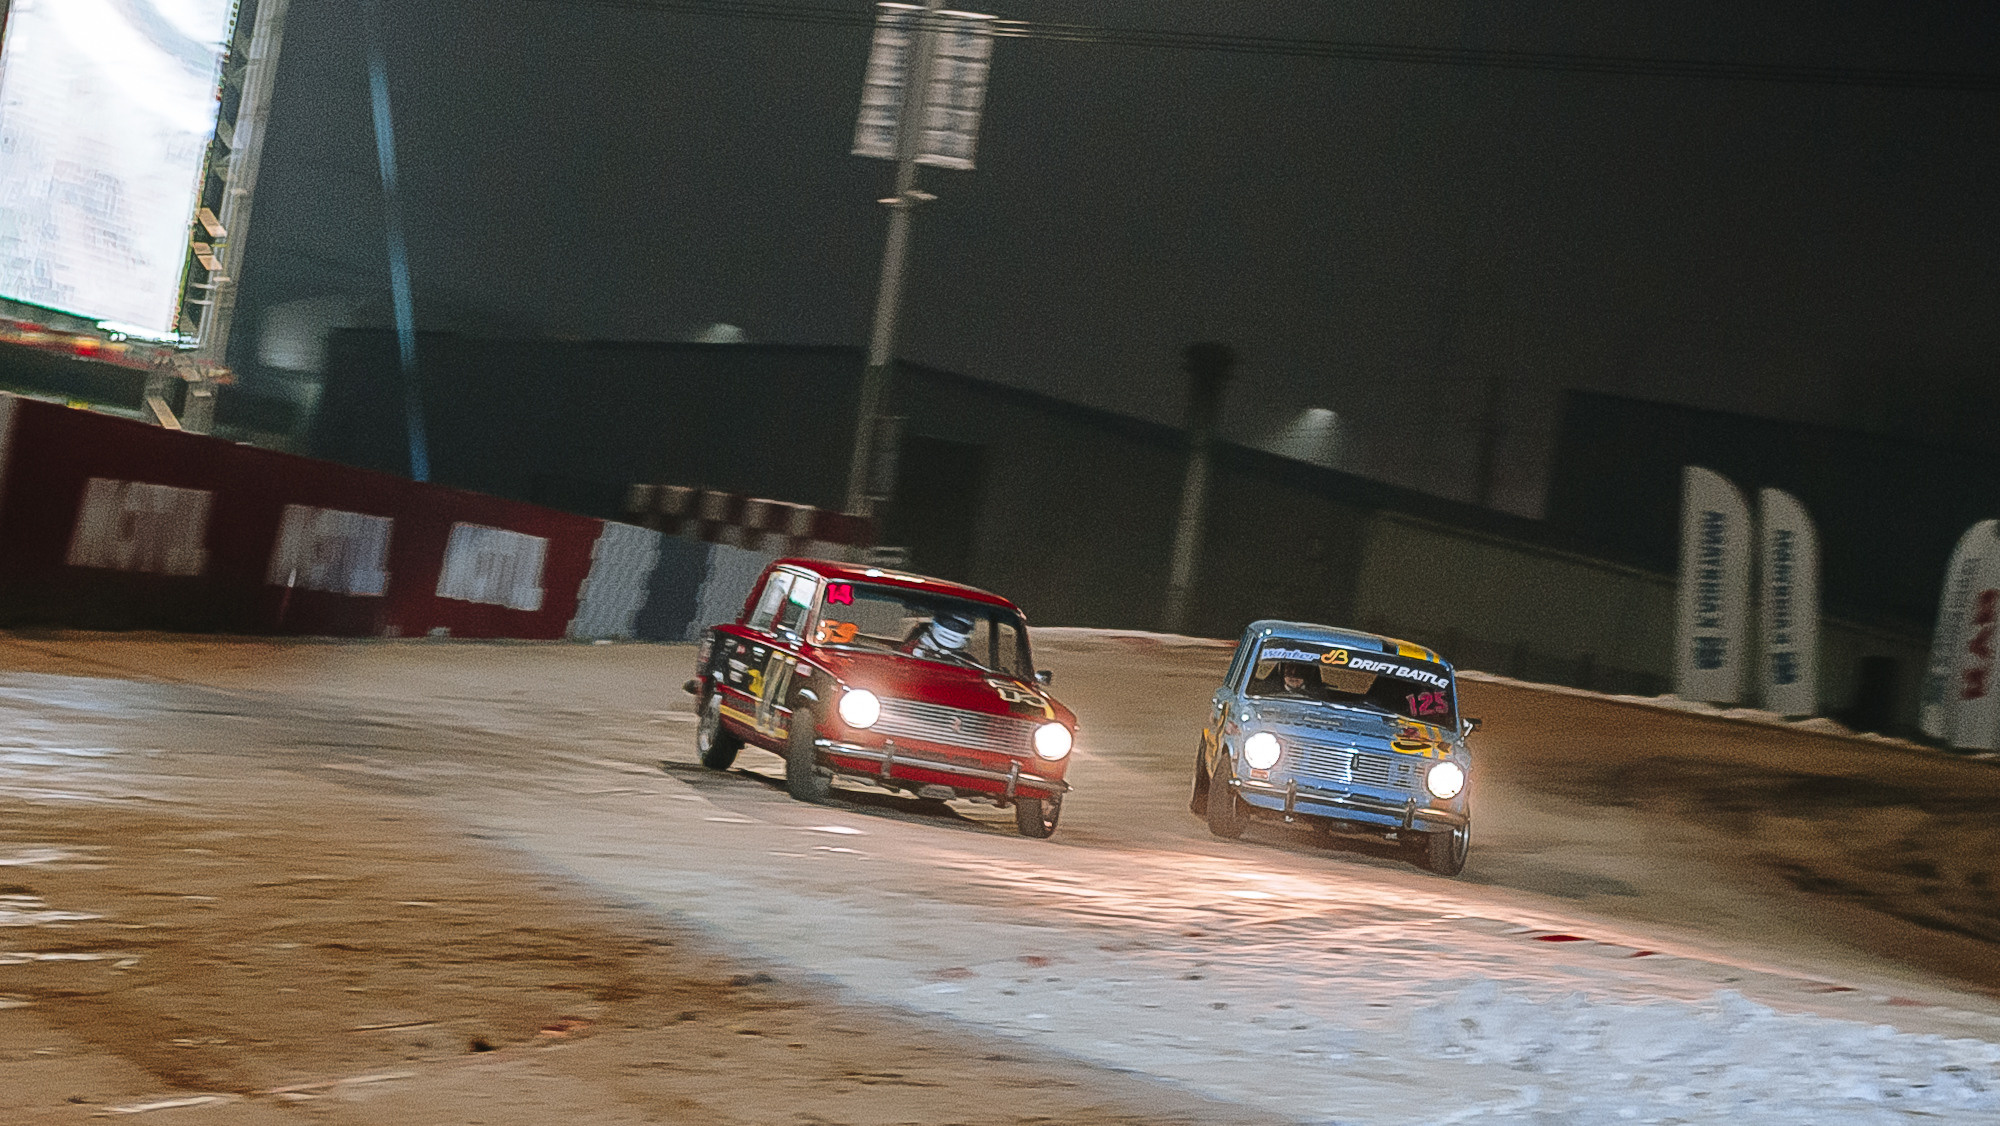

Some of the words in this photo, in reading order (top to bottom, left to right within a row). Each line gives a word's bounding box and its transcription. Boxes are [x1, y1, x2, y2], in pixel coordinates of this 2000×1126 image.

[1348, 657, 1398, 675] DRIFT
[1395, 666, 1450, 689] BATTLE
[1406, 691, 1449, 717] 125
